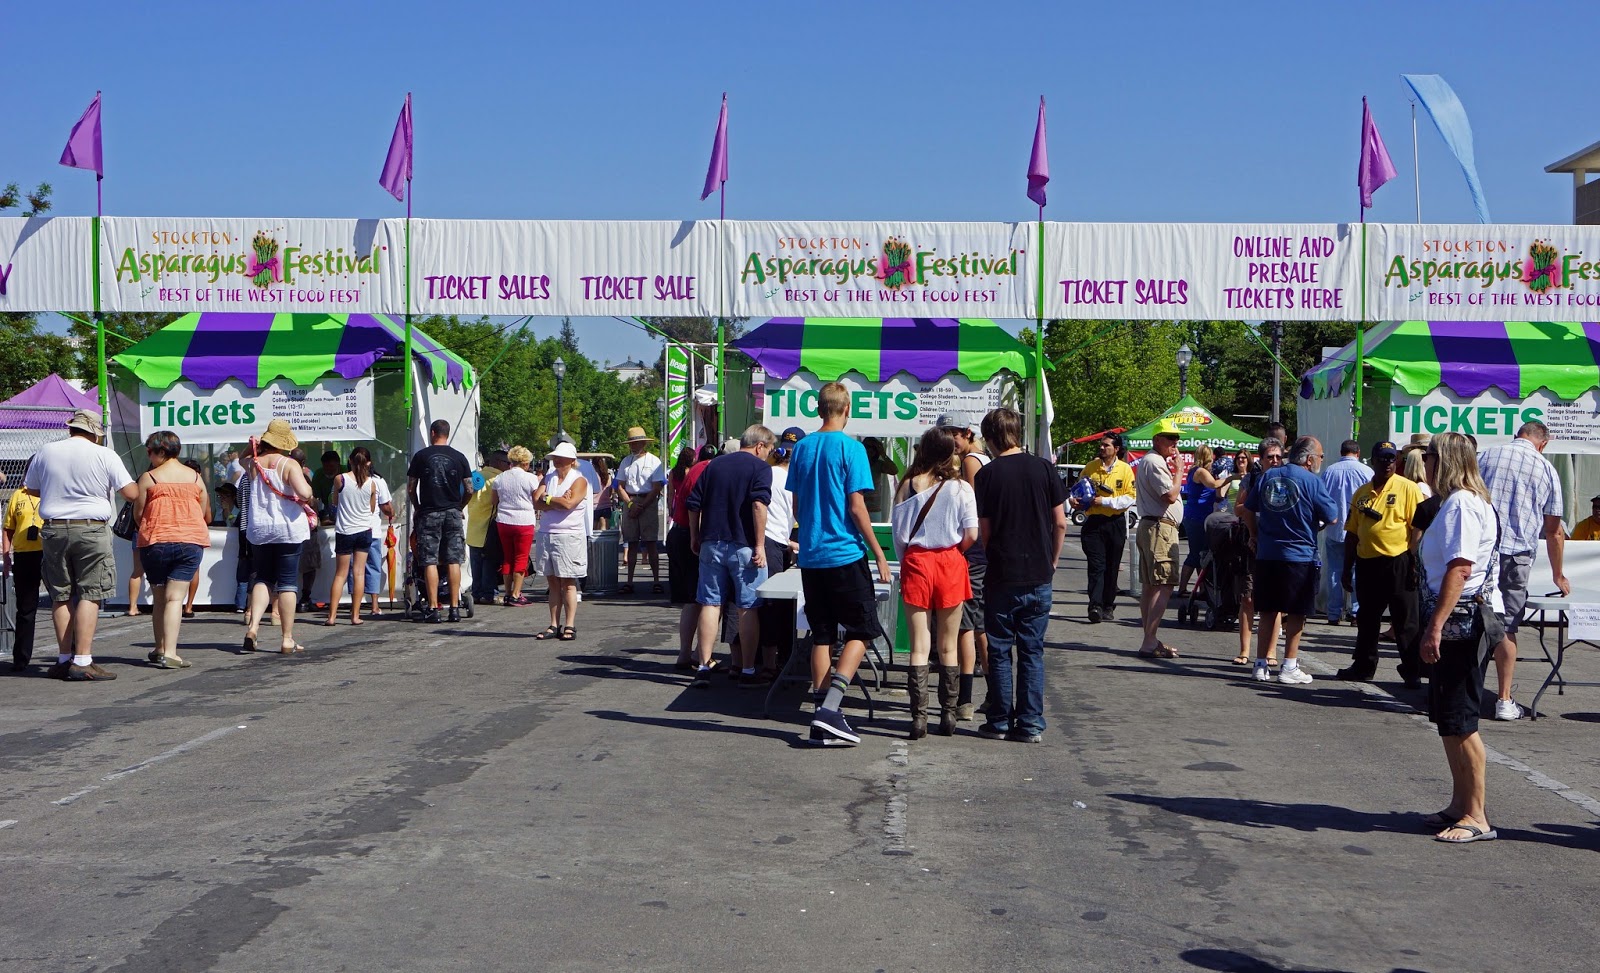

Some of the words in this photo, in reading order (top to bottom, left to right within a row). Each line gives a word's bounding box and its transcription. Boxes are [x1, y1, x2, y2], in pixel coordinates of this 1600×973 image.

[152, 231, 231, 245] STOCKTON
[778, 237, 862, 250] STOCKTON
[1233, 236, 1293, 258] ONLINE
[1299, 236, 1335, 258] AND
[1423, 240, 1507, 253] STOCKTON
[116, 247, 247, 284] Asparagus
[283, 245, 381, 284] Festival
[741, 251, 878, 285] Asparagus
[915, 248, 1017, 285] Festival
[1248, 262, 1319, 284] PRESALE
[1384, 254, 1524, 288] Asparagus
[159, 288, 190, 302] BEST
[196, 288, 213, 302] OF
[217, 288, 243, 302] THE
[248, 288, 285, 303] WEST
[289, 289, 325, 303] FOOD
[330, 289, 361, 304] FEST
[424, 275, 492, 300] TICKET
[498, 275, 550, 300] SALES
[580, 275, 648, 300] TICKET
[654, 275, 696, 300] SALE
[785, 289, 819, 303] BEST
[824, 289, 842, 302] OF
[846, 289, 873, 302] THE
[879, 289, 917, 303] WEST
[922, 290, 960, 303] FOOD
[964, 290, 998, 303] FEST
[1059, 279, 1129, 305] TICKET
[1134, 279, 1189, 305] SALES
[1223, 287, 1295, 309] TICKETS
[1301, 288, 1344, 309] HERE
[1429, 293, 1461, 306] BEST
[1468, 293, 1485, 306] OF
[1491, 293, 1517, 306] THE
[1524, 293, 1562, 307] WEST
[148, 400, 255, 427] Tickets
[766, 389, 918, 420] TICETS
[1391, 405, 1543, 435] TICKETS
